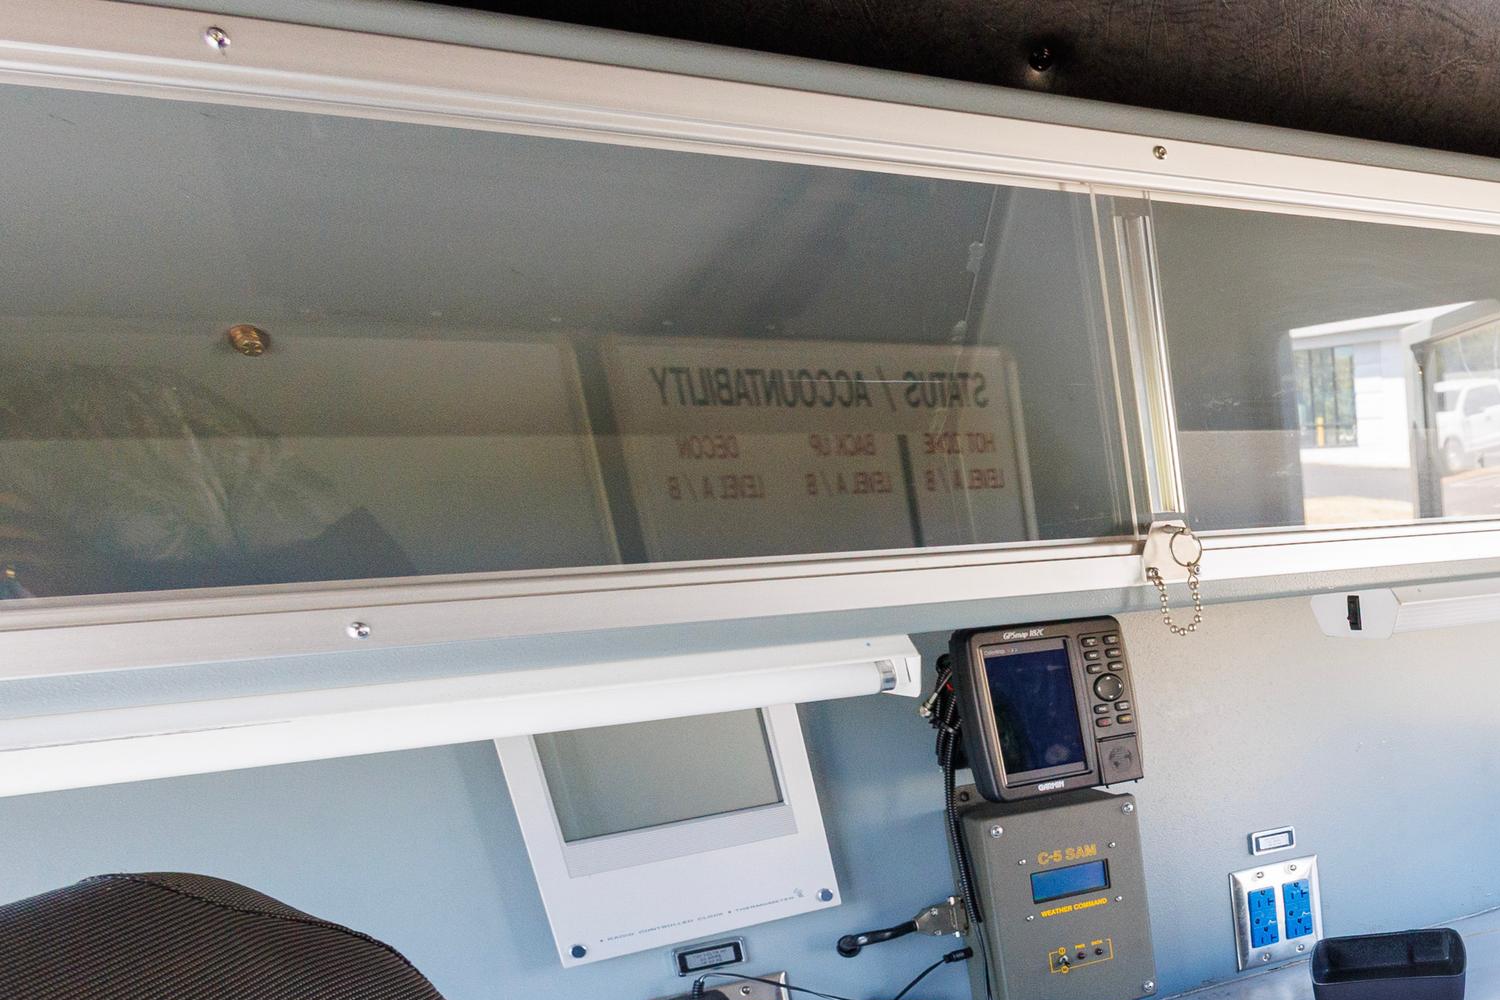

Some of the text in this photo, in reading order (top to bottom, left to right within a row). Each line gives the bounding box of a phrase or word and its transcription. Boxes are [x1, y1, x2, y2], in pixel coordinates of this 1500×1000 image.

[1065, 843, 1097, 861] SAM
[1040, 897, 1108, 918] WEATHER COMMAND
